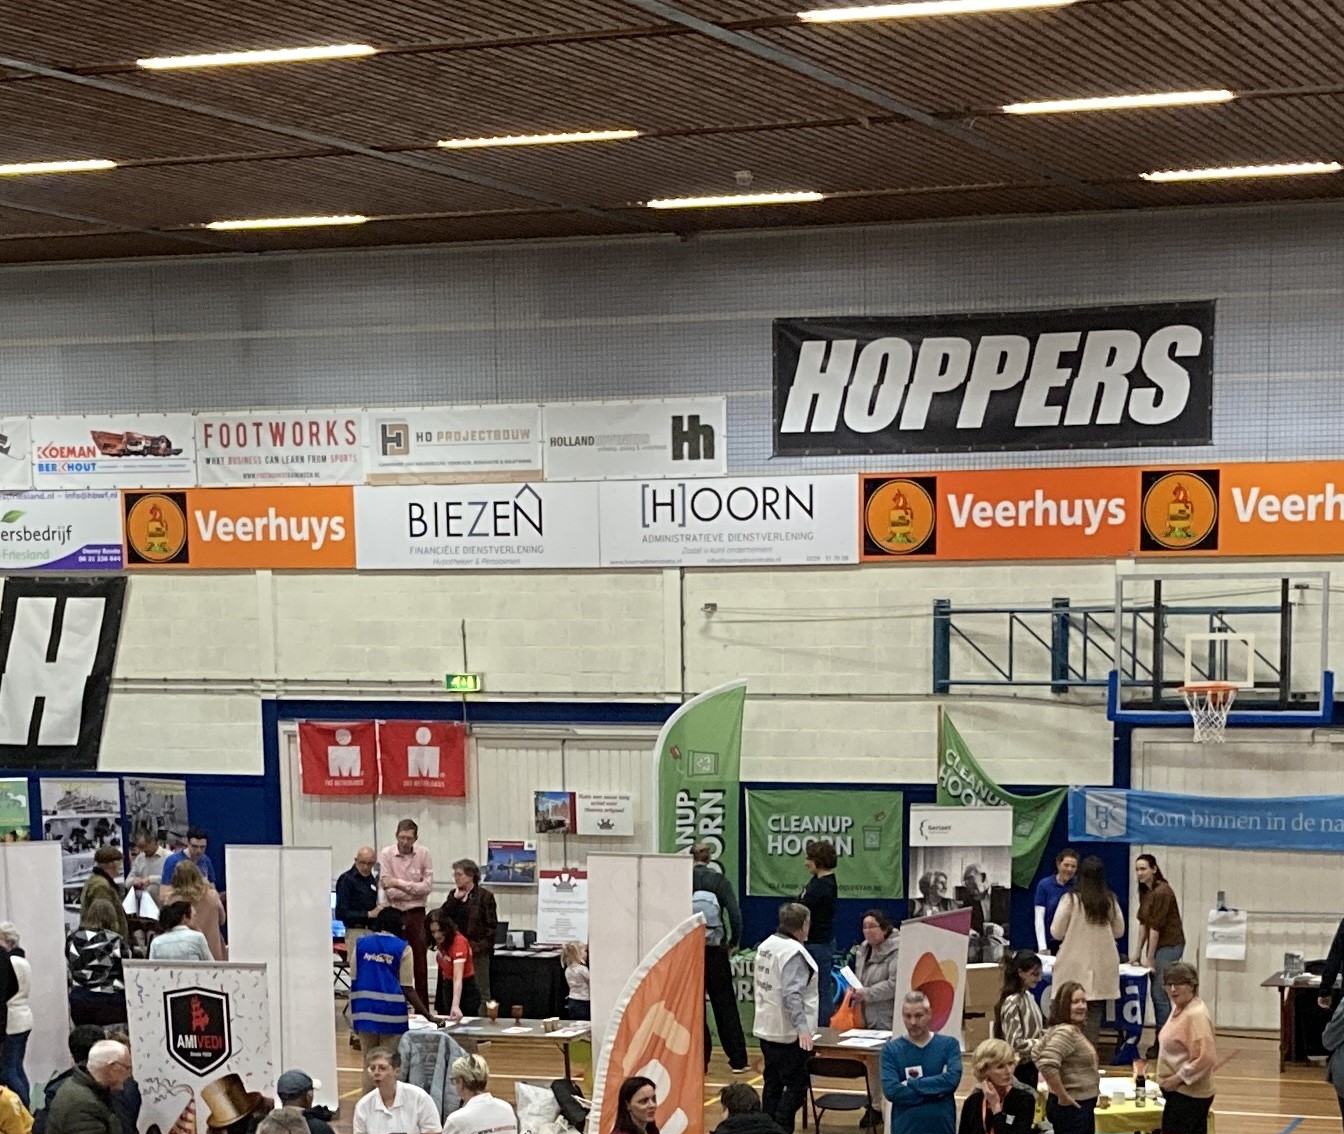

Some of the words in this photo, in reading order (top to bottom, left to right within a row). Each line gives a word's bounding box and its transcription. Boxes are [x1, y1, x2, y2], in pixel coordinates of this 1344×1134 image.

[780, 325, 1203, 433] HOPPERS
[204, 420, 356, 448] FOOTWORKS
[437, 429, 530, 442] PROJECTBOUW
[550, 436, 595, 447] HOLLAND
[37, 441, 96, 459] KOEMAN
[205, 456, 224, 465] WHAT
[228, 455, 262, 465] BUSINESS
[265, 455, 279, 464] CAN
[281, 455, 304, 464] LEARN
[307, 455, 327, 463] FROM
[330, 453, 357, 463] SPORTS
[409, 484, 543, 537] BIEZEN
[947, 489, 1127, 536] Veerhuys
[194, 508, 346, 550] Veerhuys
[642, 532, 724, 543] ADMINISTRATIEVE
[727, 531, 814, 542] DIENSTVERLENING
[409, 545, 460, 555] FINANCIËLE
[462, 545, 544, 554] DIENSTVERLENING
[945, 749, 1006, 806] CLEANU
[767, 815, 854, 833] CLEANUP
[1141, 811, 1185, 826] Kom
[1191, 811, 1260, 829] binnen
[1266, 813, 1286, 830] in
[1291, 813, 1315, 831] de
[767, 835, 854, 856] HON
[177, 1034, 222, 1049] AMIVEDI
